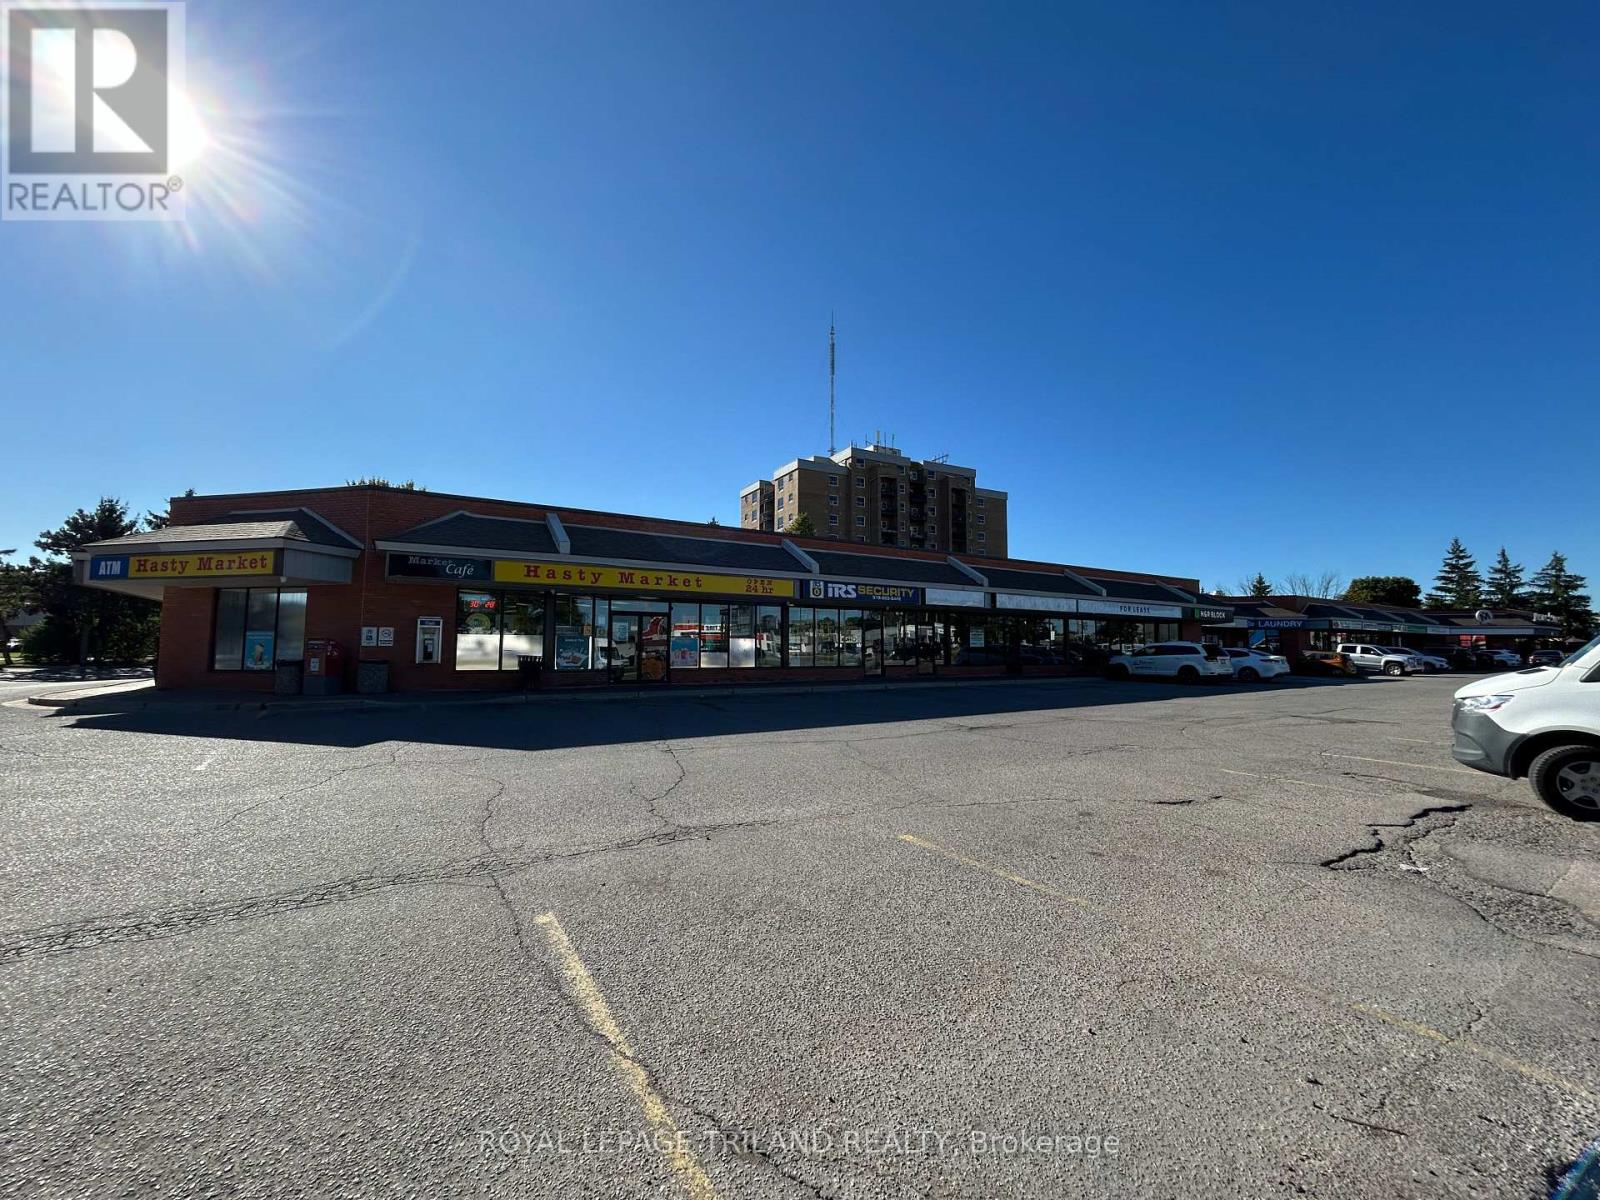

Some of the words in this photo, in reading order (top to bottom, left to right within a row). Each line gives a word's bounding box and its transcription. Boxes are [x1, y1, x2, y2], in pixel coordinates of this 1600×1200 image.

[98, 560, 121, 575] ATM
[135, 557, 189, 575] Hasty
[196, 554, 268, 571] Market
[446, 563, 475, 579] Café
[523, 564, 603, 585] Hasty
[618, 571, 702, 588] Market
[857, 584, 914, 599] SECURITY
[1258, 620, 1304, 628] LAUNDRY
